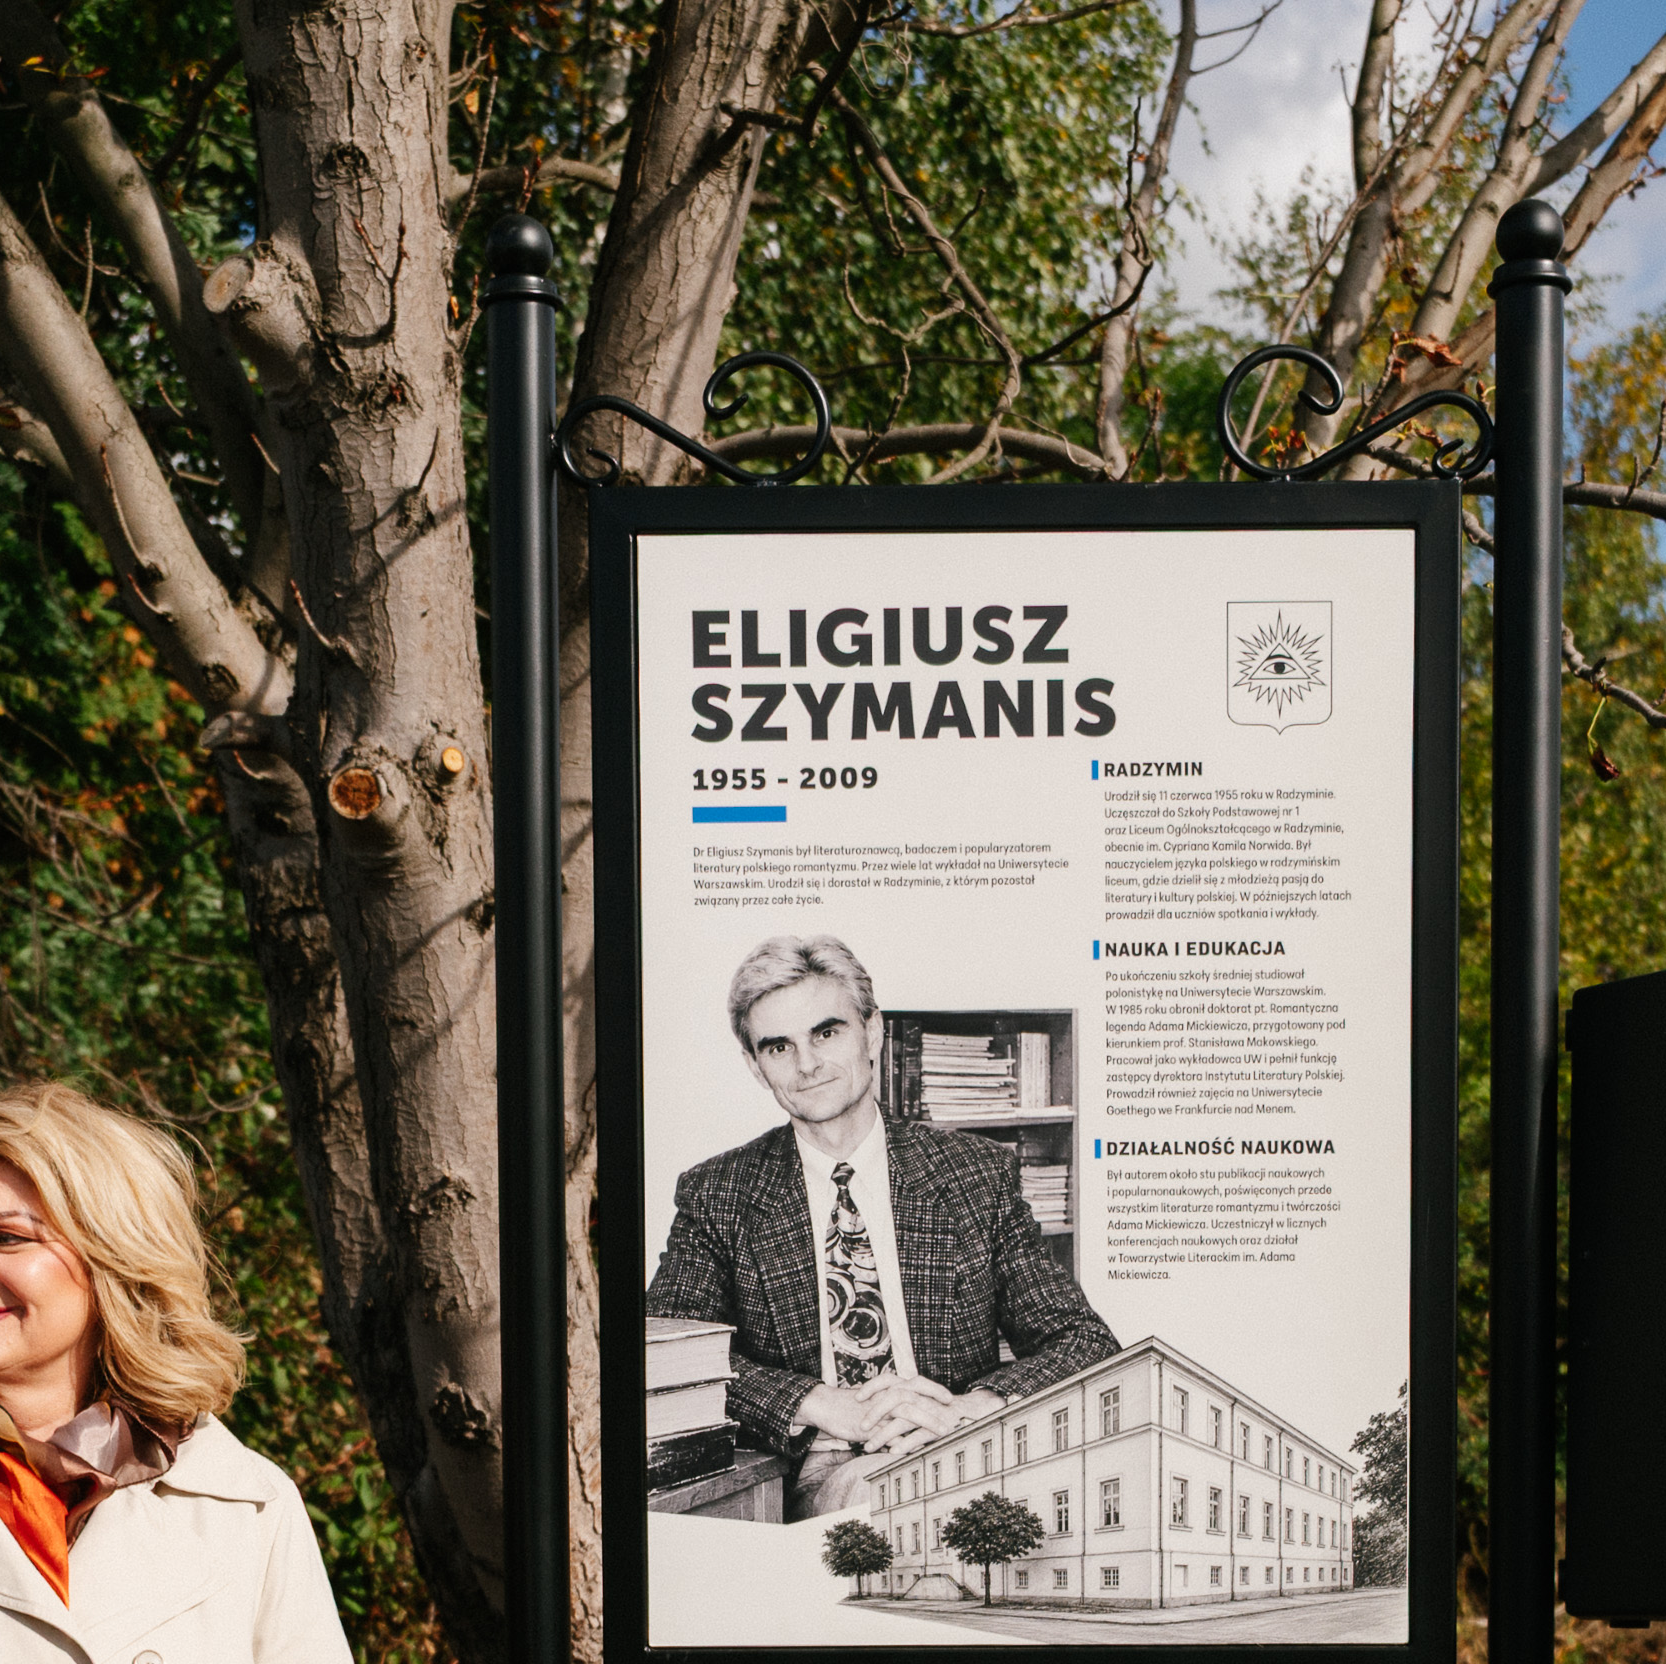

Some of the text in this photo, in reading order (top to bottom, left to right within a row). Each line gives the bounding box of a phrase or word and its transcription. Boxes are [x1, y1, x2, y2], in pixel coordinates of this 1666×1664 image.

[691, 605, 1069, 668] ELIGIUSZ
[691, 677, 1117, 743] SZYMANIS
[1103, 761, 1203, 777] RADZYMIN
[691, 767, 766, 791] 1955
[798, 766, 878, 790] 2009
[1104, 789, 1140, 801] Urodził
[1159, 789, 1168, 801] 11
[1169, 791, 1212, 801] czerwca
[1214, 788, 1238, 801] 1955
[1240, 788, 1263, 800] roku
[1162, 806, 1176, 818] do
[1177, 806, 1211, 821] Szkoły
[1212, 805, 1280, 820] Podstawowej
[1282, 808, 1293, 817] nr
[1104, 826, 1127, 836] oraz
[1128, 823, 1164, 836] Liceum
[693, 845, 705, 858] Dr
[706, 845, 744, 860] Eligiusz
[746, 844, 794, 860] Szymanis
[795, 844, 812, 859] był
[904, 842, 957, 855] badaczem
[1104, 840, 1144, 853] obecnie
[1163, 839, 1210, 855] Cypriana
[1211, 839, 1246, 852] Kamila
[1296, 838, 1312, 854] Był
[693, 861, 741, 876] literatury
[742, 860, 791, 876] polskiego
[861, 859, 888, 872] Przez
[890, 859, 917, 871] wiele
[918, 859, 933, 871] lat
[934, 858, 981, 873] wykładał
[983, 861, 996, 870] na
[1209, 856, 1258, 871] polskiego
[742, 896, 769, 908] przez
[771, 893, 794, 905] całe
[1105, 908, 1155, 923] prowadził
[1156, 907, 1173, 920] dla
[1218, 907, 1268, 922] spotkania
[1104, 940, 1286, 957] NAUKA I EDUKACJA
[1105, 969, 1118, 982] Po
[1178, 968, 1211, 984] szkoły
[1254, 968, 1305, 980] studiował
[1165, 988, 1178, 998] na
[1119, 1003, 1143, 1015] 1985
[1144, 1002, 1167, 1015] roku
[1168, 1002, 1205, 1015] obronił
[1207, 1002, 1252, 1014] doktorat
[1269, 1001, 1339, 1017] Romantyczna
[1105, 1020, 1146, 1035] legenda
[1148, 1020, 1184, 1032] Adama
[1326, 1018, 1346, 1033] pod
[1105, 1037, 1161, 1049] kierunkiem
[1188, 1036, 1245, 1048] Stanisława
[1106, 1053, 1153, 1066] Pracował
[1154, 1053, 1177, 1068] jako
[1178, 1053, 1242, 1068] wykładowca
[1243, 1053, 1262, 1065] UW
[1269, 1052, 1298, 1067] pełnił
[1153, 1070, 1203, 1085] dyrektora
[1205, 1069, 1251, 1084] Instytutu
[1253, 1069, 1303, 1084] Literatury
[1106, 1087, 1156, 1099] Prowadził
[1236, 1089, 1249, 1098] na
[1106, 1103, 1156, 1119] Goethego
[1157, 1106, 1173, 1116] we
[1174, 1103, 1232, 1115] Frankfurcie
[1234, 1103, 1254, 1115] nad
[1106, 1137, 1335, 1155] DZIAŁALNOŚĆ NAUKOWA
[1107, 1167, 1325, 1183] Był autorem około stu publikacji naukowych
[1297, 1183, 1332, 1198] przede
[1106, 1201, 1159, 1217] wszystkim
[1160, 1201, 1214, 1213] literaturze
[1215, 1201, 1279, 1216] romantyzmu
[1107, 1218, 1143, 1230] Adama
[1286, 1216, 1327, 1232] licznych
[1180, 1234, 1238, 1249] naukowych
[1239, 1236, 1262, 1246] oraz
[1263, 1233, 1299, 1246] działał
[1187, 1250, 1241, 1263] Literackim
[1259, 1250, 1296, 1262] Adama
